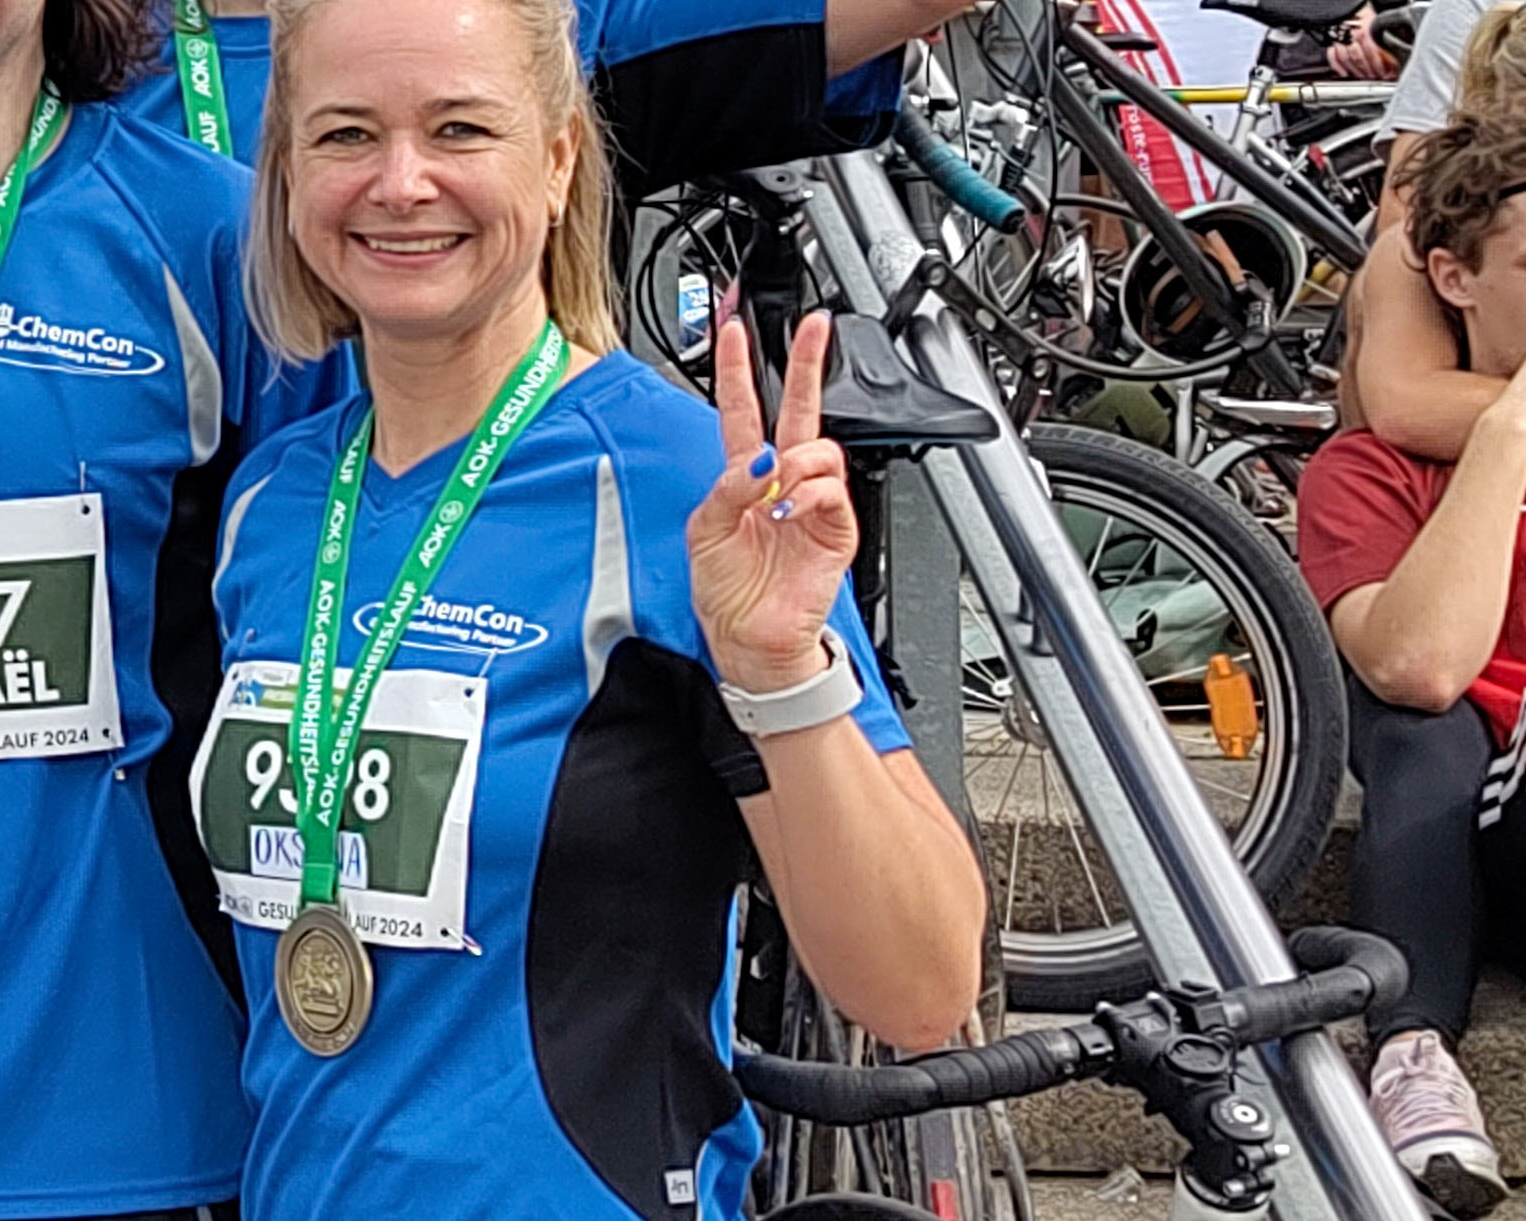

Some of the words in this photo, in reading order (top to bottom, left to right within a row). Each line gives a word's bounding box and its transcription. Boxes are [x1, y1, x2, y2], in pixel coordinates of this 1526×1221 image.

[191, 57, 214, 98] AOK
[17, 315, 134, 356] ChemCon
[460, 324, 565, 489] AOK-GESUNDHEITS
[326, 498, 348, 542] AOK
[417, 523, 451, 569] AOK
[419, 594, 524, 635] hemCon
[315, 580, 418, 827] AOK-GESUNDHEITSLAUF
[45, 729, 90, 746] 2024
[245, 739, 392, 821] 98
[254, 828, 362, 879] OKSA
[380, 919, 424, 938] 2024
